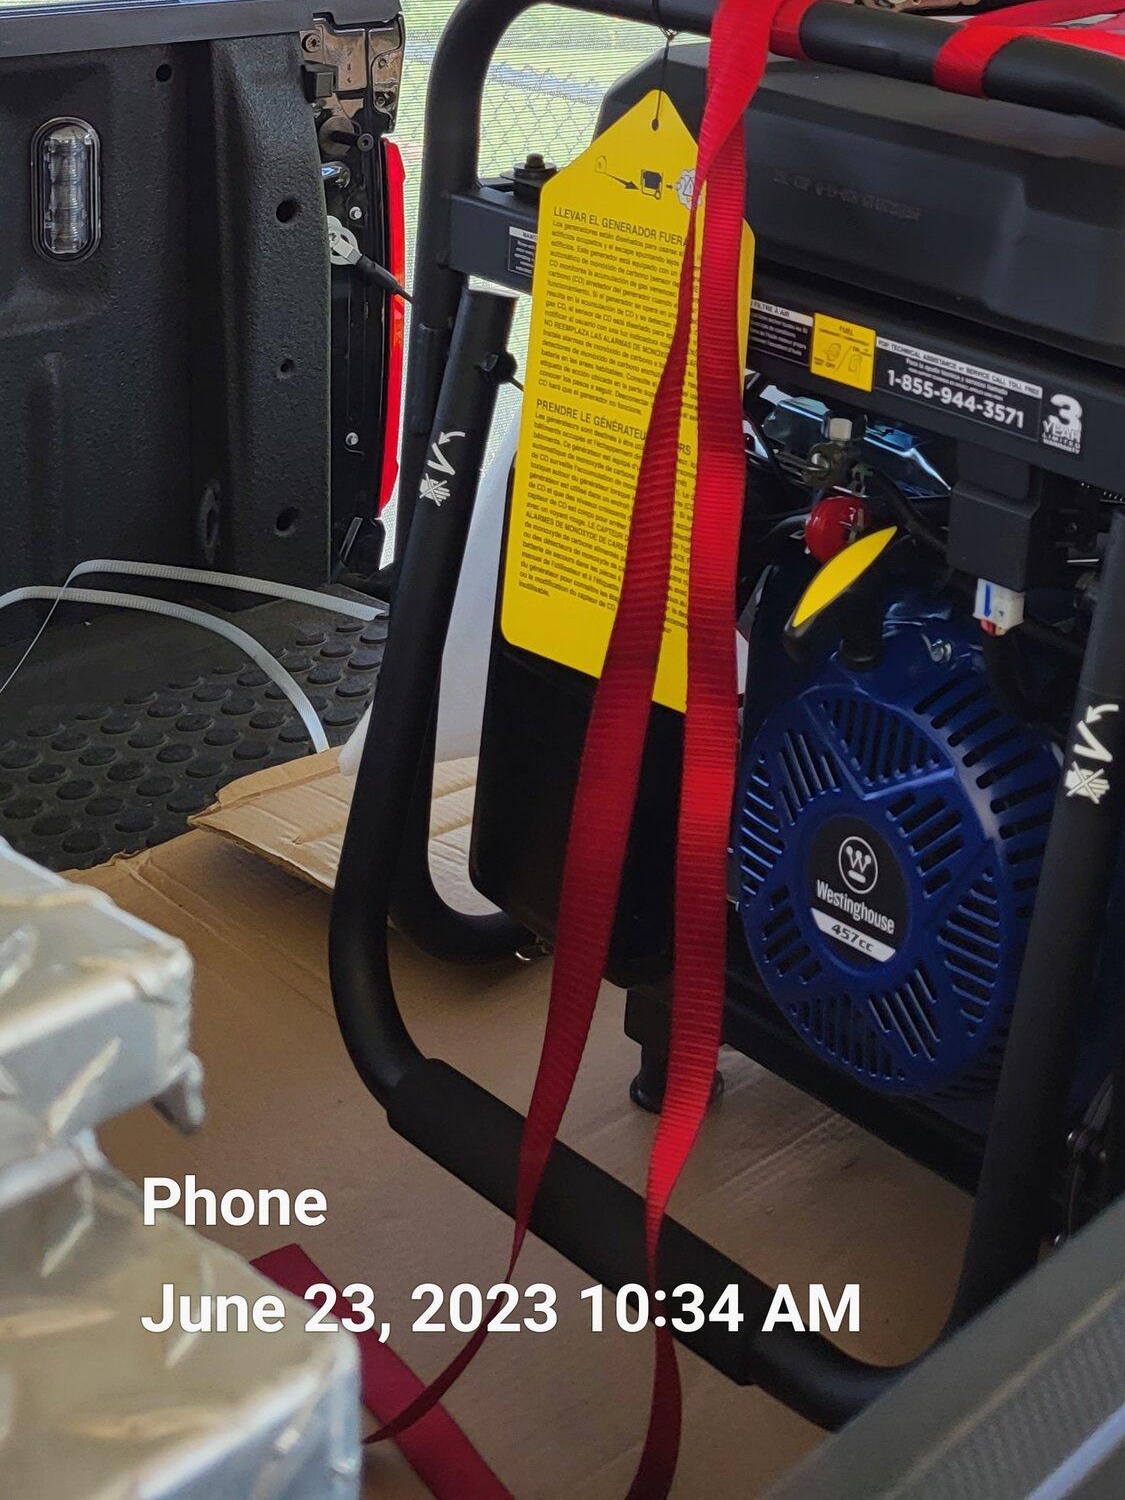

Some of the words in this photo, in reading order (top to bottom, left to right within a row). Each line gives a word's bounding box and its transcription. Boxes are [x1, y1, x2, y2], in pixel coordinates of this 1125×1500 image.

[553, 206, 586, 223] LLEVAR
[588, 214, 600, 226] EL
[601, 217, 656, 239] GENERADOR
[887, 369, 1024, 429] 1-855-944-3571
[966, 366, 990, 380] SERVICE
[991, 375, 1006, 386] CALL
[1008, 380, 1022, 390] TOLL
[1024, 385, 1039, 395] FREE
[536, 397, 577, 419] PRENDRE
[580, 411, 590, 423] LE
[593, 412, 645, 440] GÉNÉRATEU
[1050, 393, 1083, 431] 3
[817, 879, 894, 935] Westinghouse
[831, 924, 874, 952] 457cc
